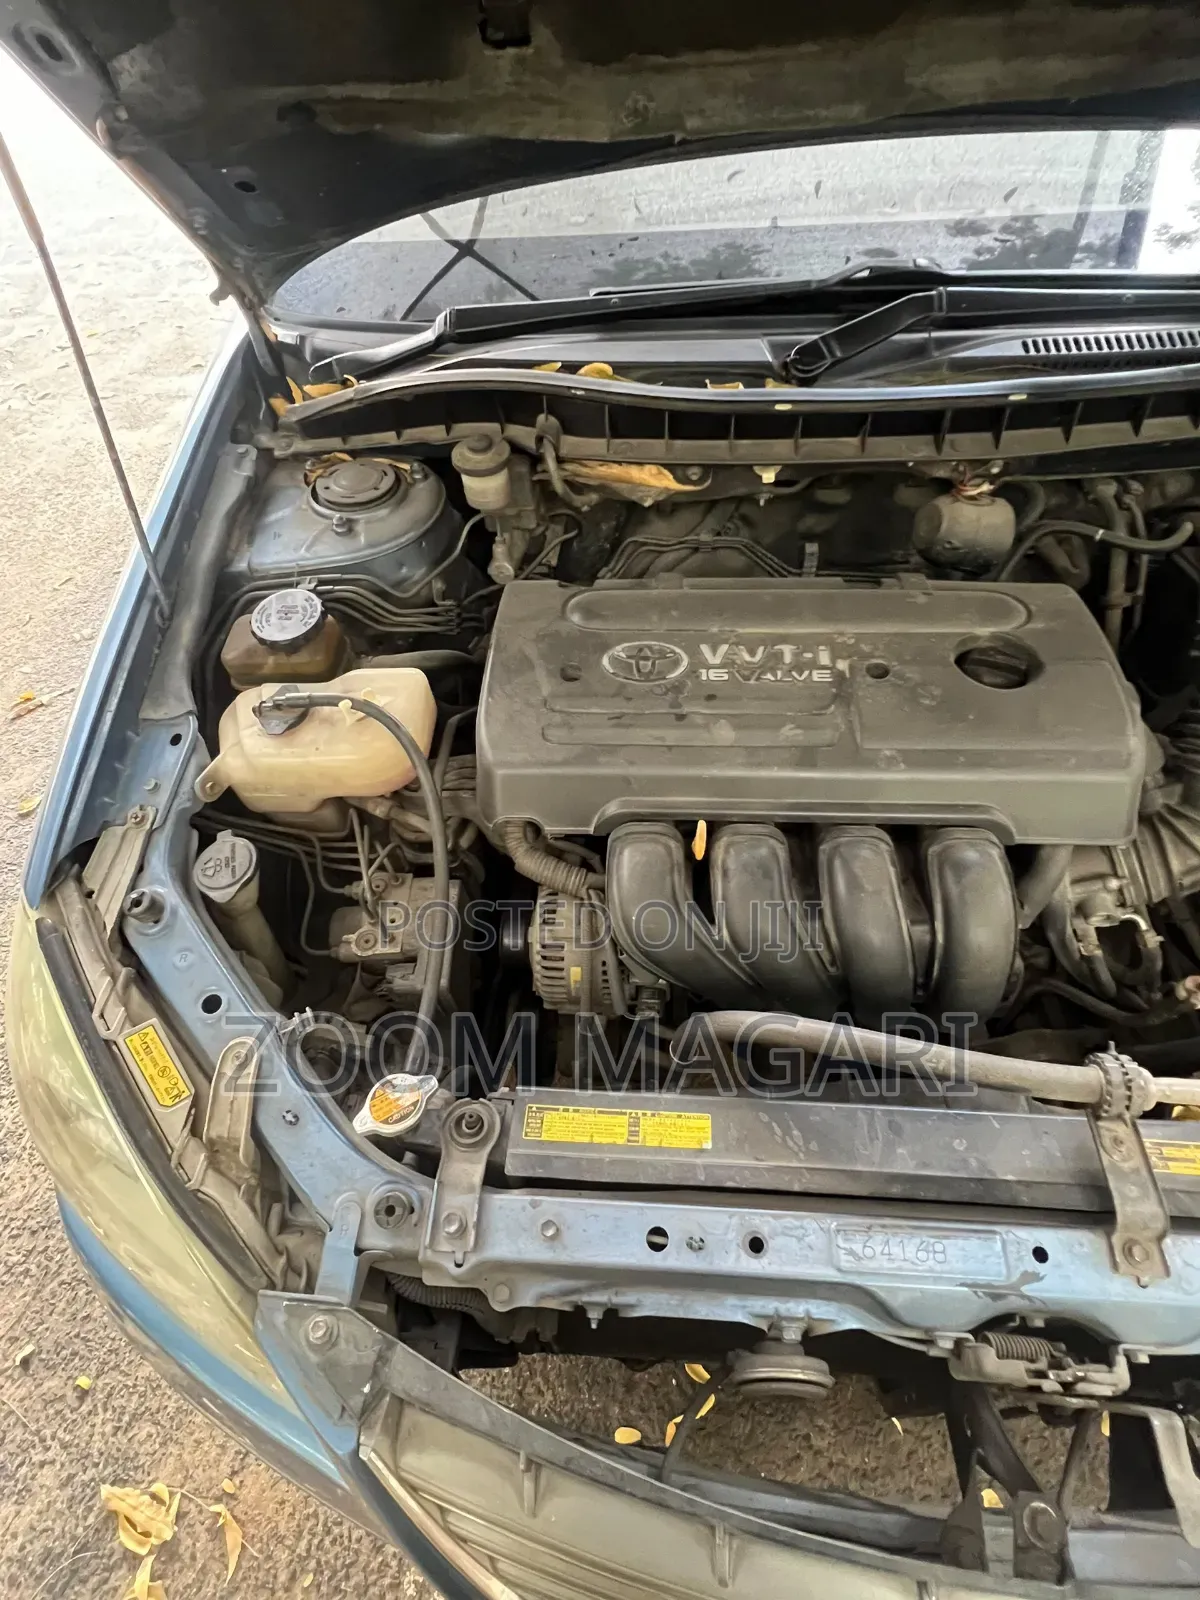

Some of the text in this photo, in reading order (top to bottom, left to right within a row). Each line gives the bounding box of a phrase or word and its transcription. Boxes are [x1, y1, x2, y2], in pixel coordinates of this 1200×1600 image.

[698, 668, 833, 683] 16 VALVE
[861, 1235, 947, 1264] 64168
